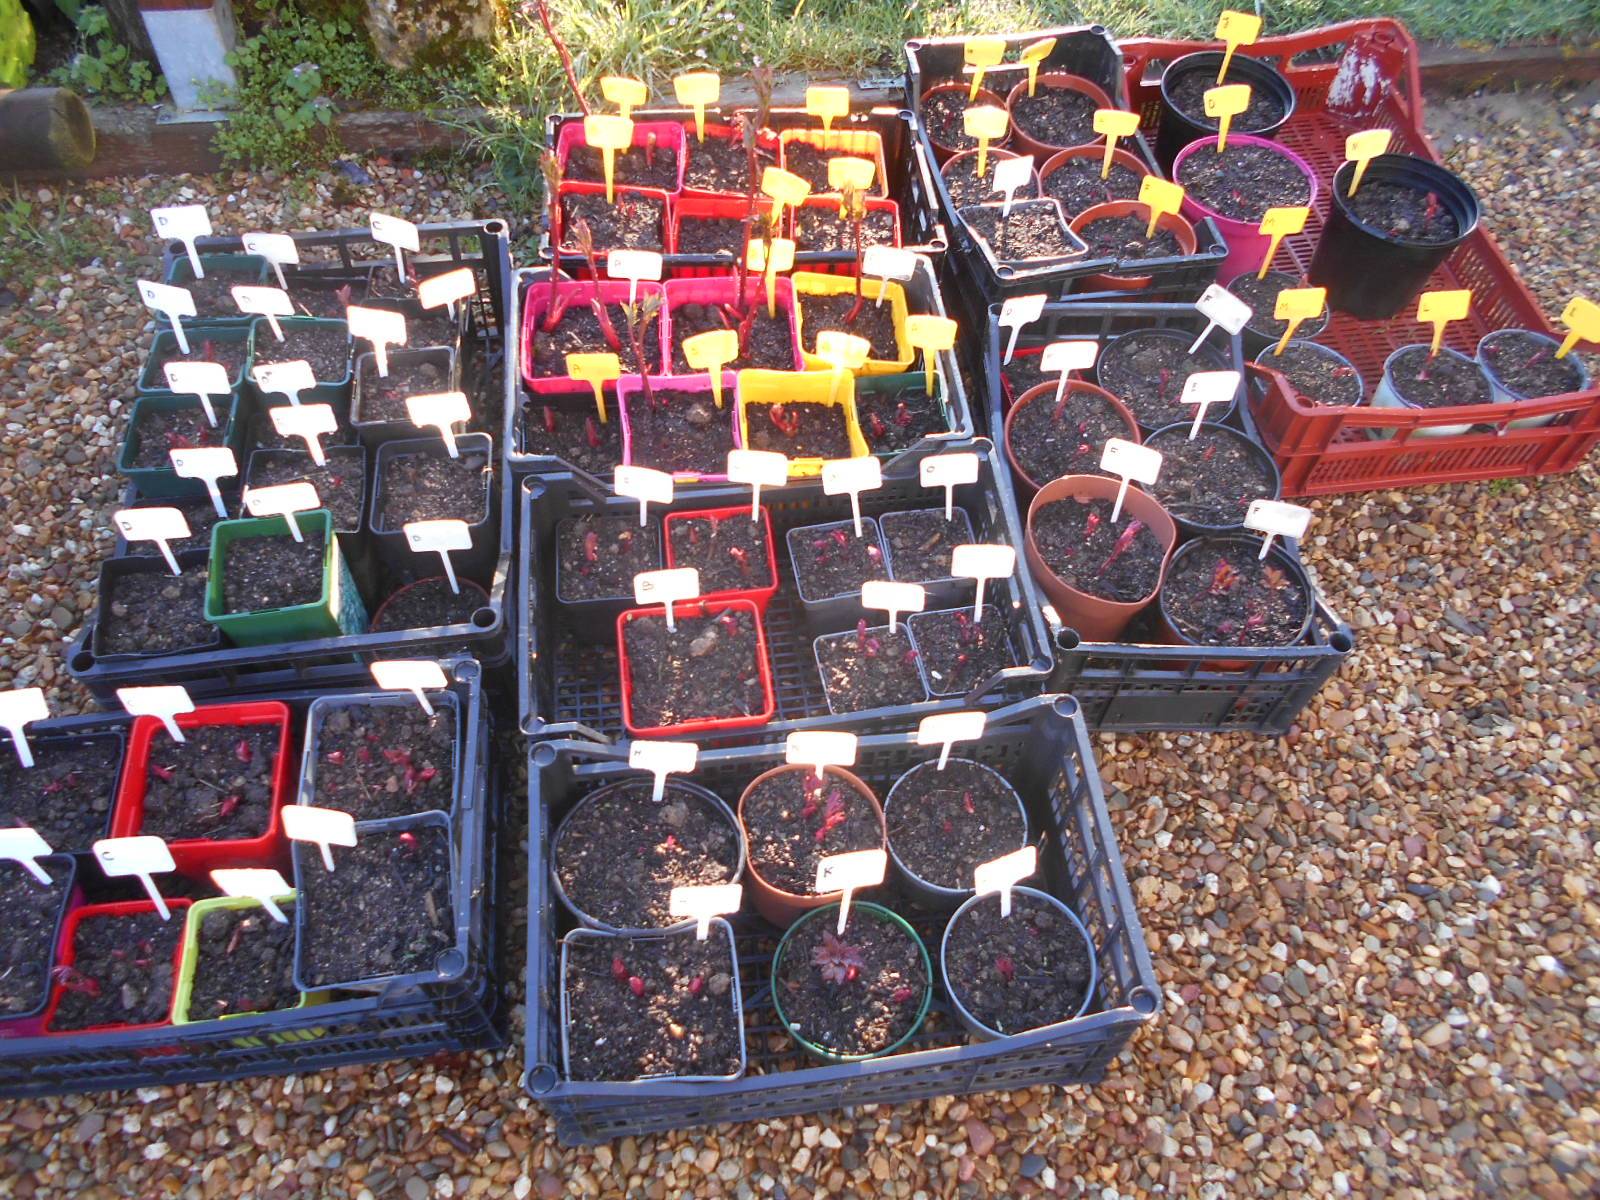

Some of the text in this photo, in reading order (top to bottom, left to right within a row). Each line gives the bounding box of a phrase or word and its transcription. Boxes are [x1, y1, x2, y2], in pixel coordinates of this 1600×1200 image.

[158, 216, 169, 226] D
[1202, 294, 1213, 303] F
[1252, 506, 1261, 515] F
[823, 866, 834, 878] K
